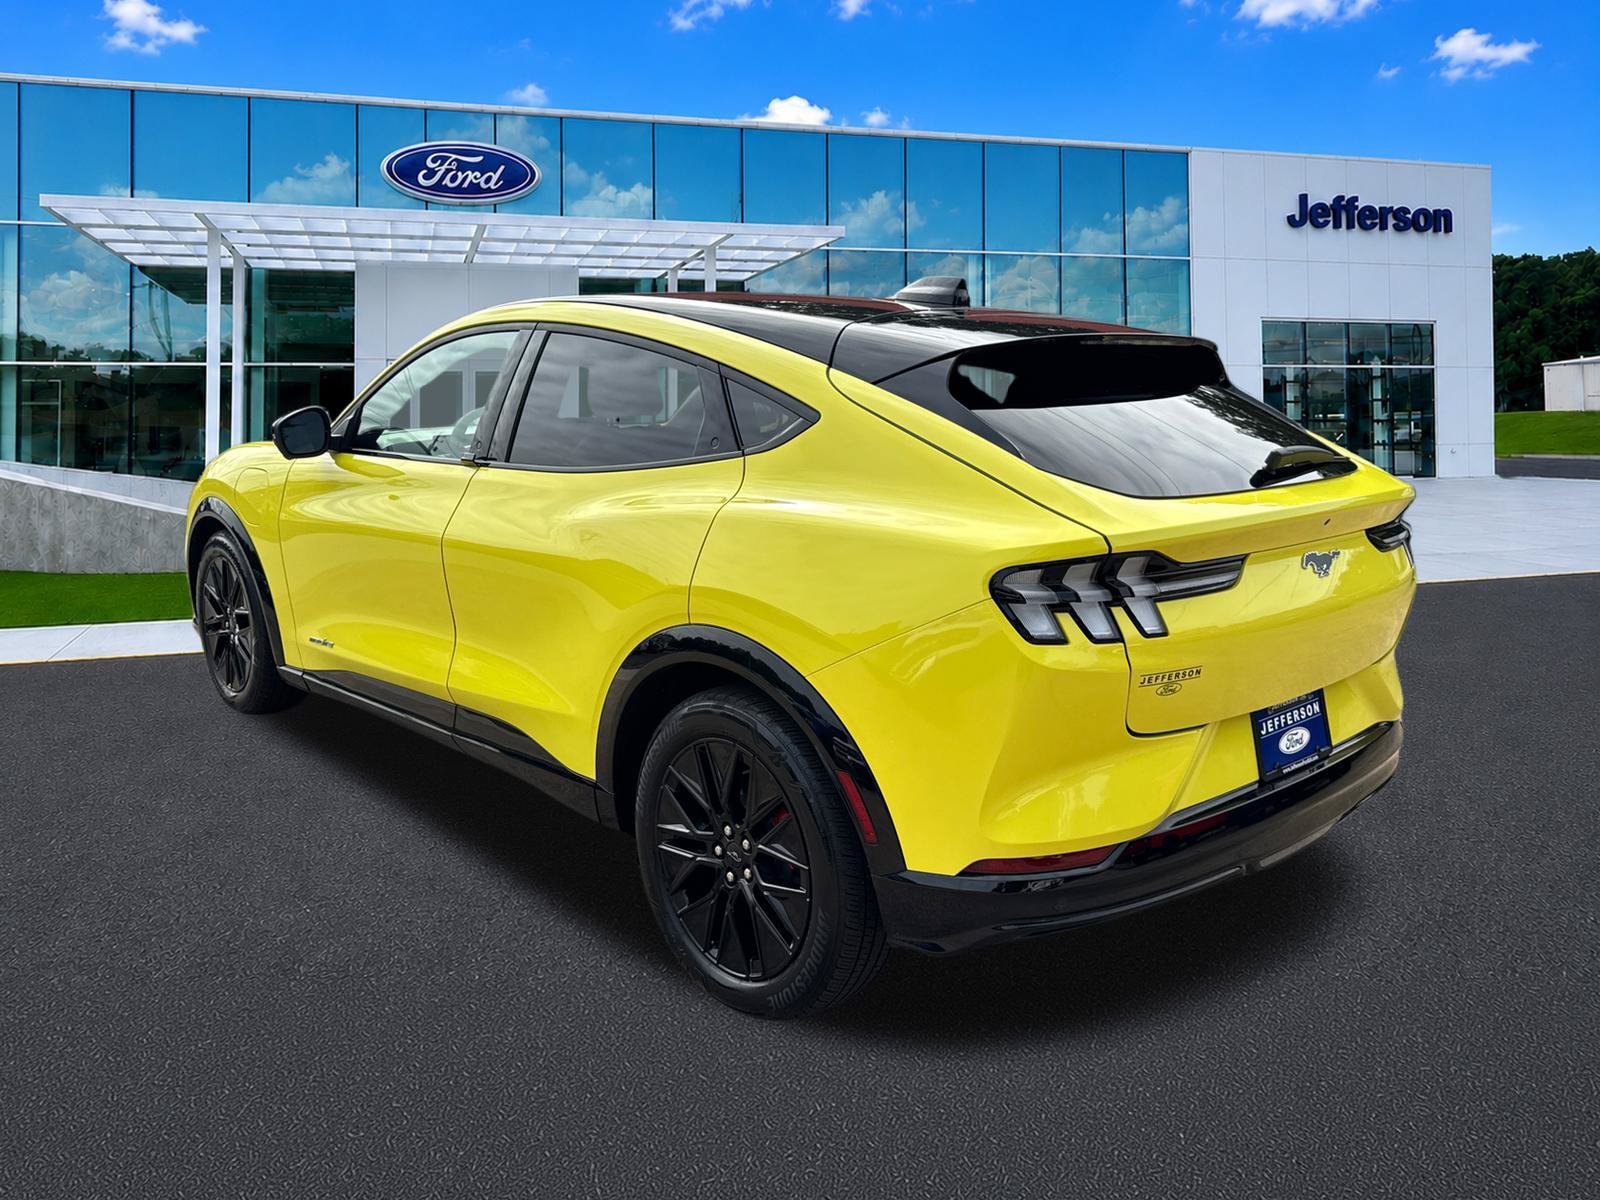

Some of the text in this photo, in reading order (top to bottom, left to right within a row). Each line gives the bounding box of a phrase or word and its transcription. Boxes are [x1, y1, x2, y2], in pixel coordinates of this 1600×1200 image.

[417, 152, 505, 190] Ford
[1286, 193, 1453, 233] Jefferson
[1140, 668, 1202, 685] JEFFERSON
[1159, 683, 1179, 696] Ford
[1260, 701, 1320, 735] JEFFERSON
[1285, 731, 1304, 750] Ford
